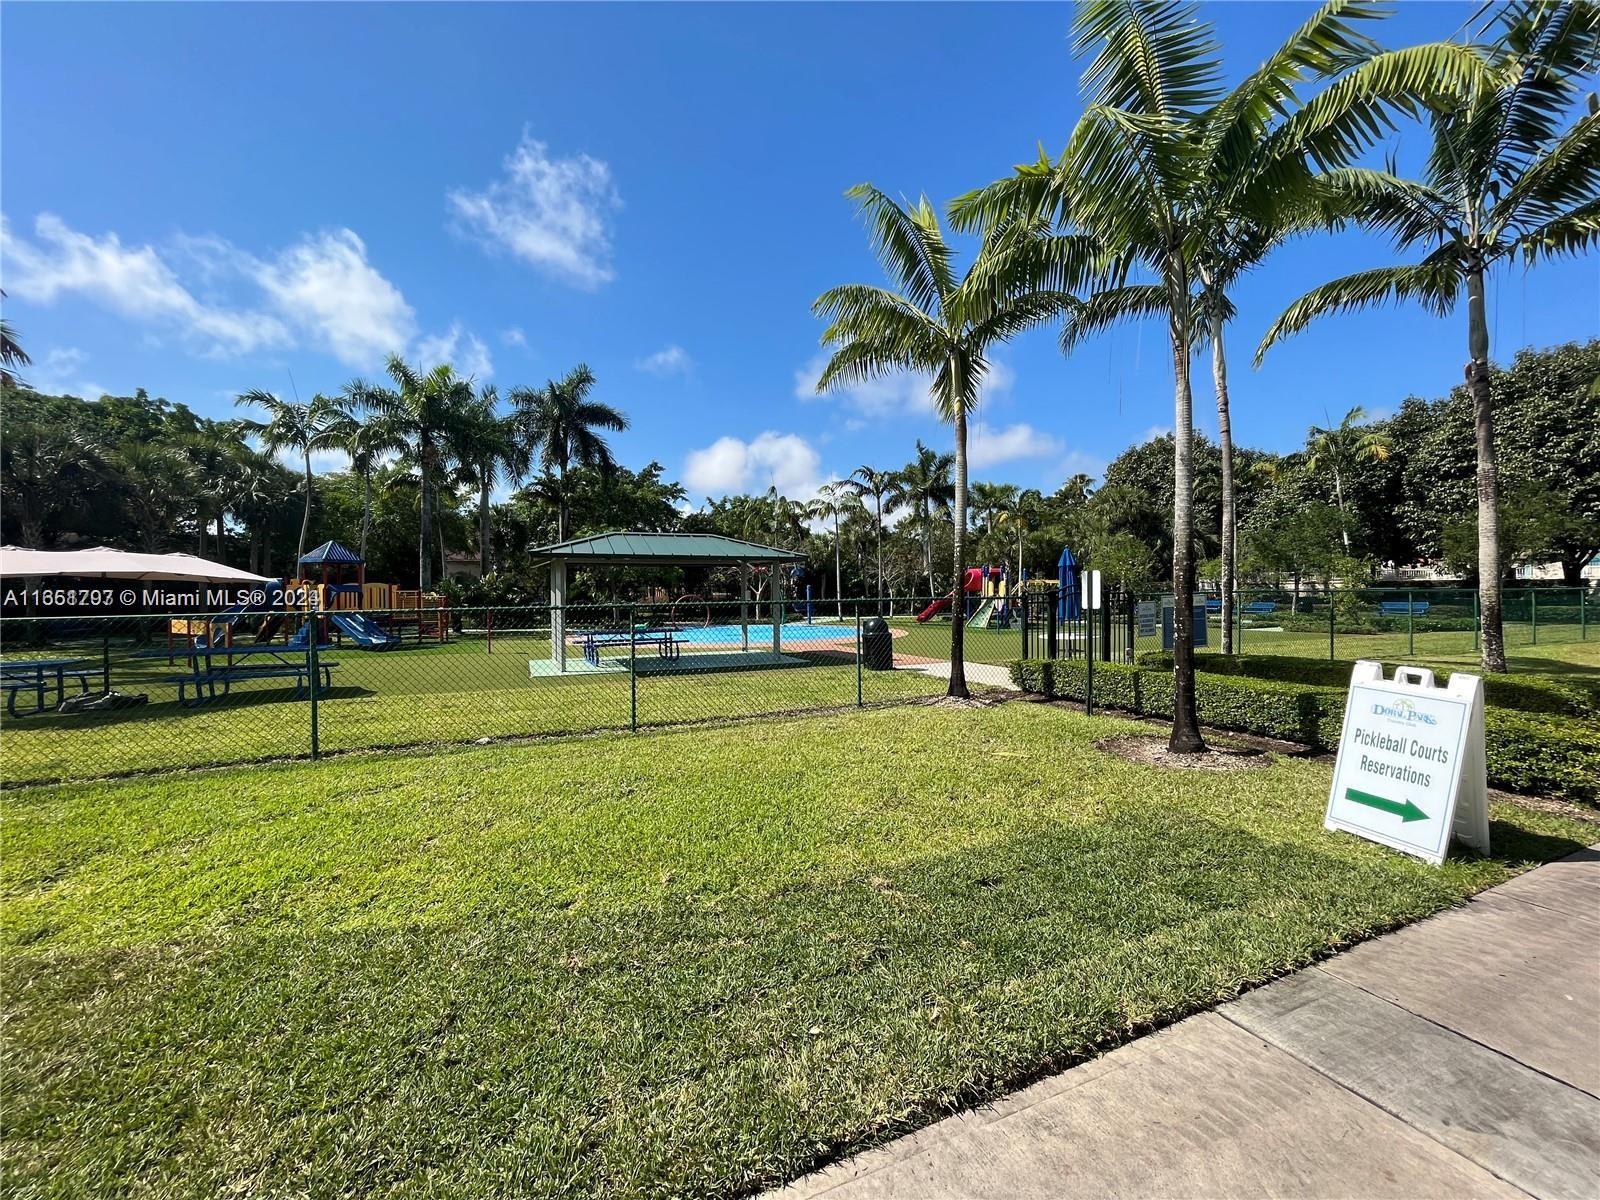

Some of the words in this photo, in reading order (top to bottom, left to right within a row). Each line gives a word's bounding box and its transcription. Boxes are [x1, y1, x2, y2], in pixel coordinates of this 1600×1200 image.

[1354, 728, 1408, 754] Pickleball
[1410, 739, 1449, 764] Courts
[1360, 754, 1431, 787] Reservations
